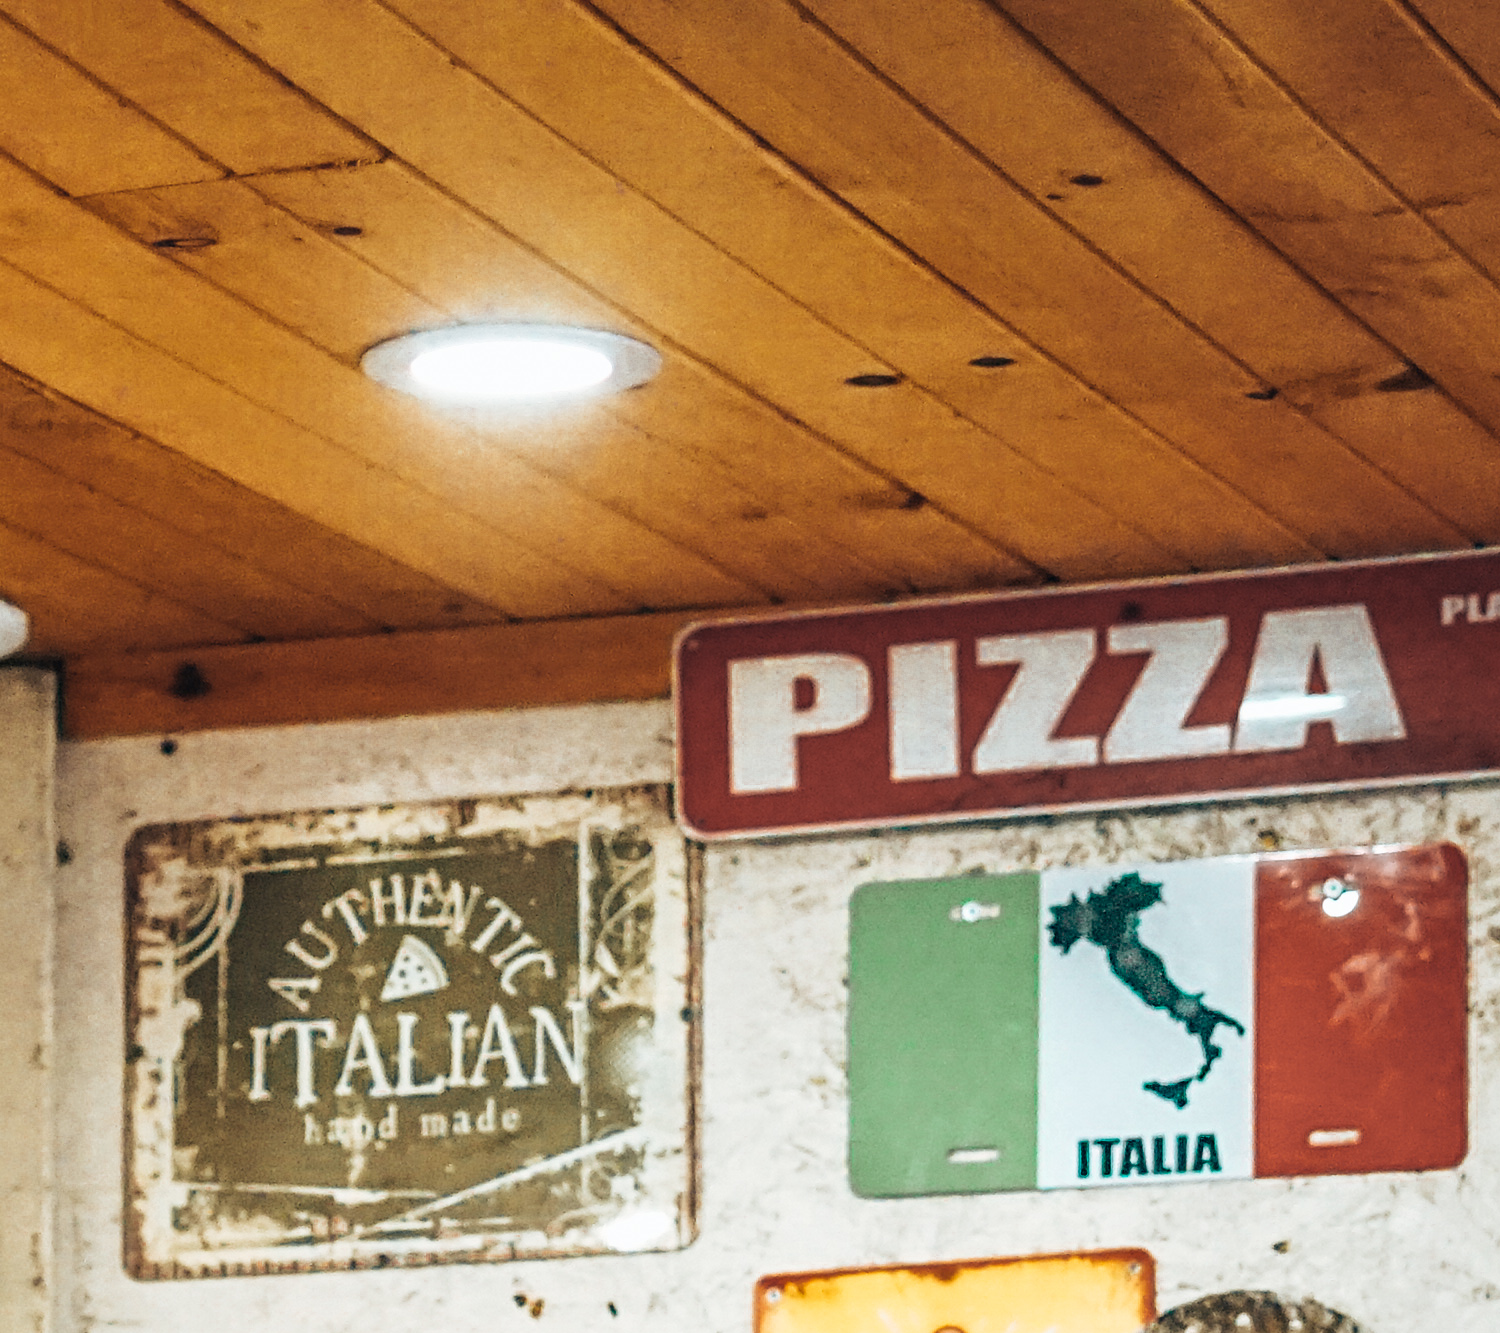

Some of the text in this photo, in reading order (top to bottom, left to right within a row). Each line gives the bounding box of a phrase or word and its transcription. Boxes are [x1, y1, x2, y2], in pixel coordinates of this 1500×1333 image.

[728, 604, 1407, 797] PIZZA
[269, 868, 557, 1012] AUTHENTIC
[247, 1000, 588, 1107] ITALIAN
[420, 1096, 521, 1138] made
[1076, 1133, 1222, 1179] ITALIA
